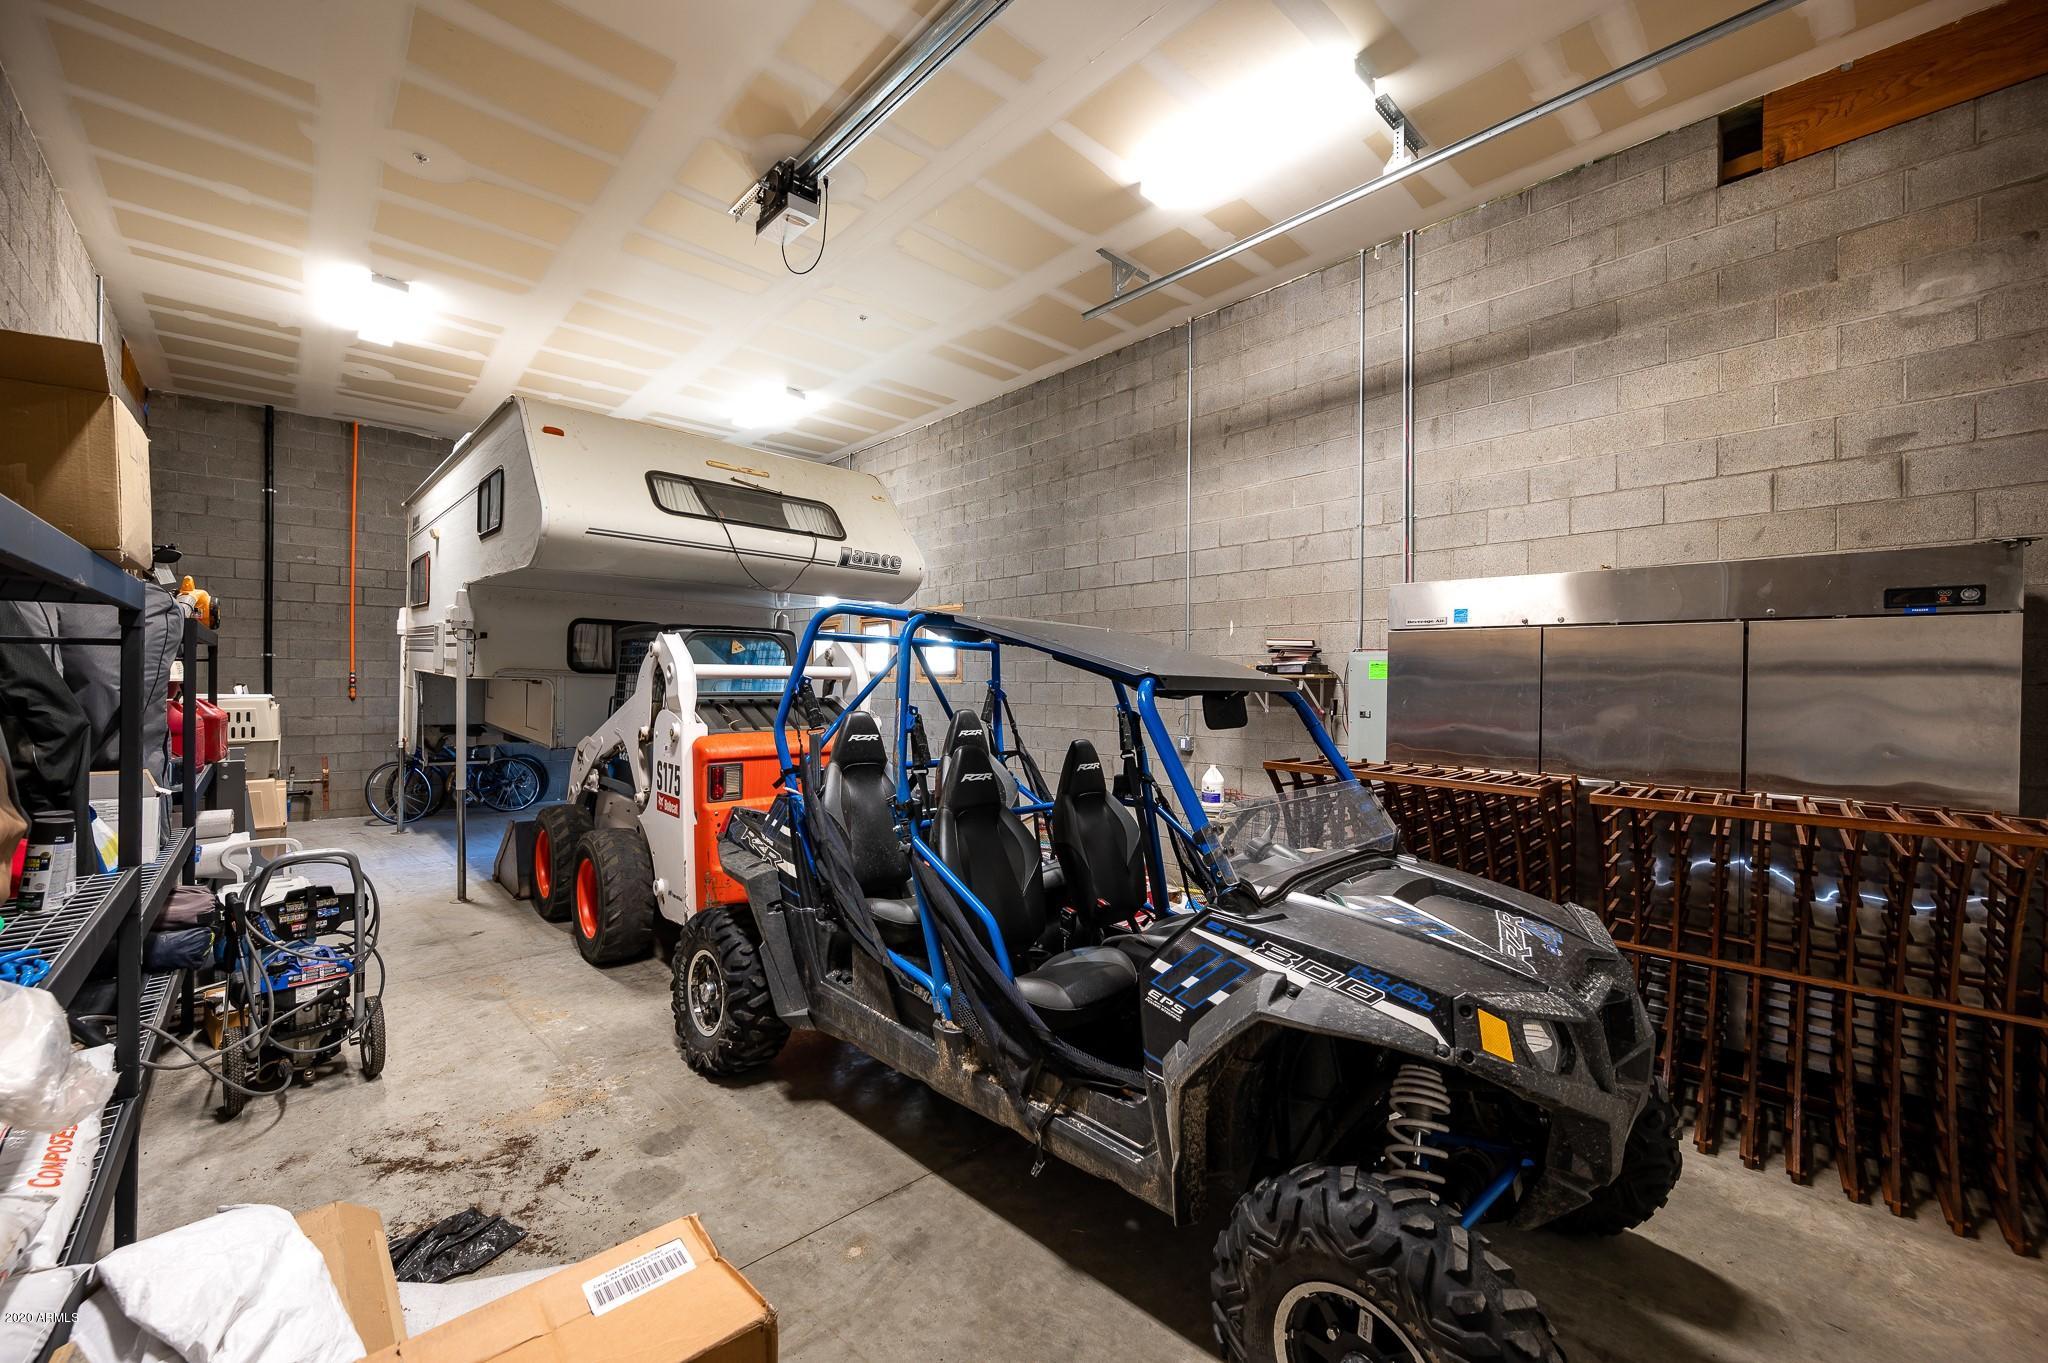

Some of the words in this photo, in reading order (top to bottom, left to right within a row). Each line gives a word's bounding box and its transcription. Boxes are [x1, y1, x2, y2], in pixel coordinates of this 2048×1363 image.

[838, 547, 902, 571] Lance
[848, 734, 880, 742] RZR
[958, 729, 983, 737] RZR
[656, 760, 681, 796] S175
[960, 773, 993, 783] RZR
[1076, 762, 1100, 772] RZR
[1495, 909, 1538, 974] RZR
[679, 956, 688, 1012] BIGHORN
[1252, 940, 1386, 1006] 800
[1147, 989, 1187, 1015] EPS
